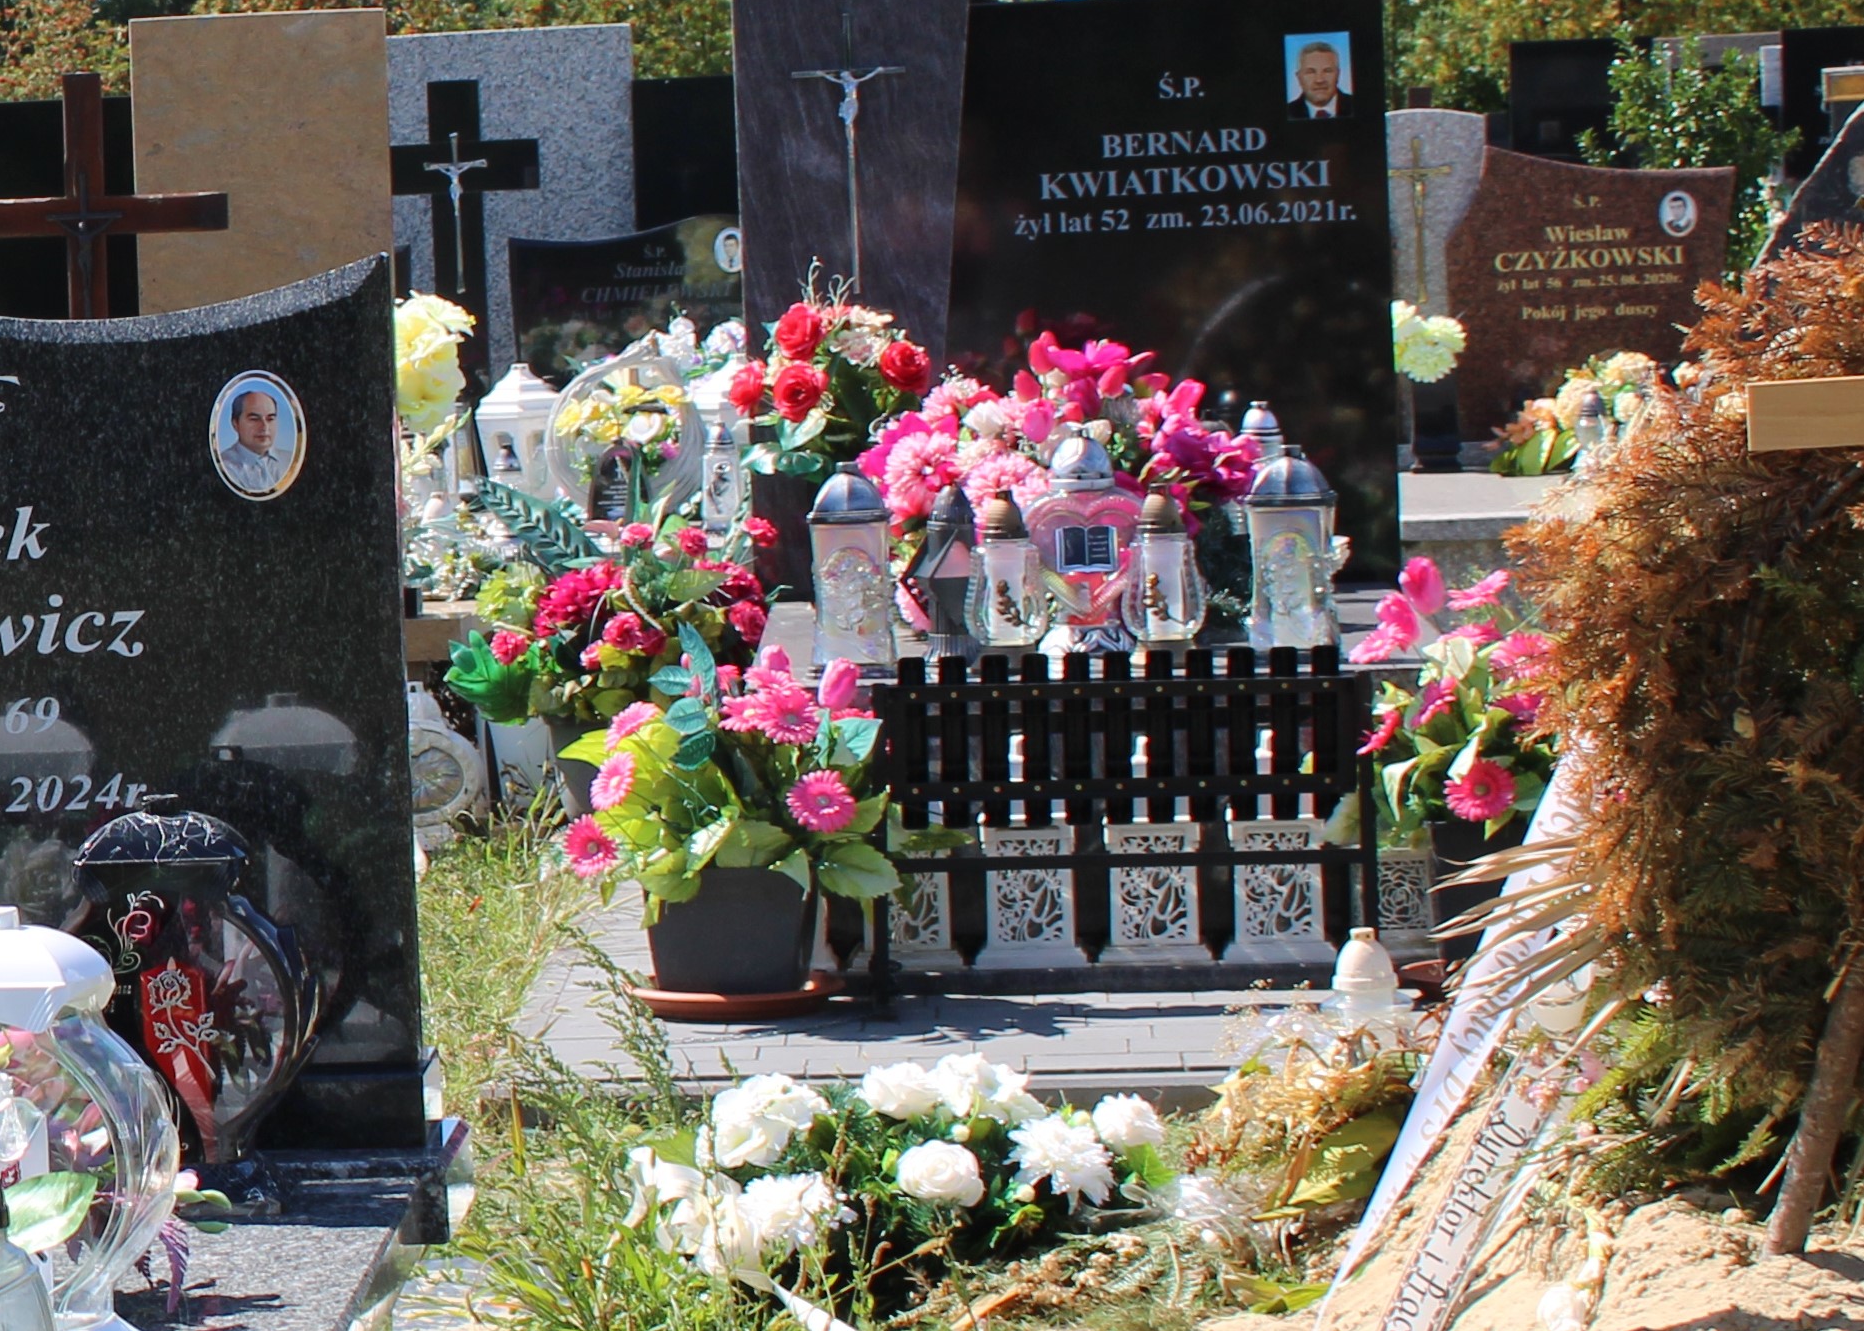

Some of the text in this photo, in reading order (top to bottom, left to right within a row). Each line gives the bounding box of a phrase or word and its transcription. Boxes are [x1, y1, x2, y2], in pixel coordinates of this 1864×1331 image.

[1159, 72, 1205, 98] Ś.P.
[1102, 127, 1267, 158] BERNARD
[1040, 160, 1331, 200] KWIATKOWSKI
[1015, 200, 1357, 240] żył lat 52 zm. 23.06.2021r.
[1494, 246, 1685, 272] CZYŻKOWSKI
[1523, 303, 1659, 321] Pokój jego duszy
[4, 696, 61, 735] 69
[1434, 1110, 1529, 1247] Dyrektor
[1425, 1250, 1449, 1265] i
